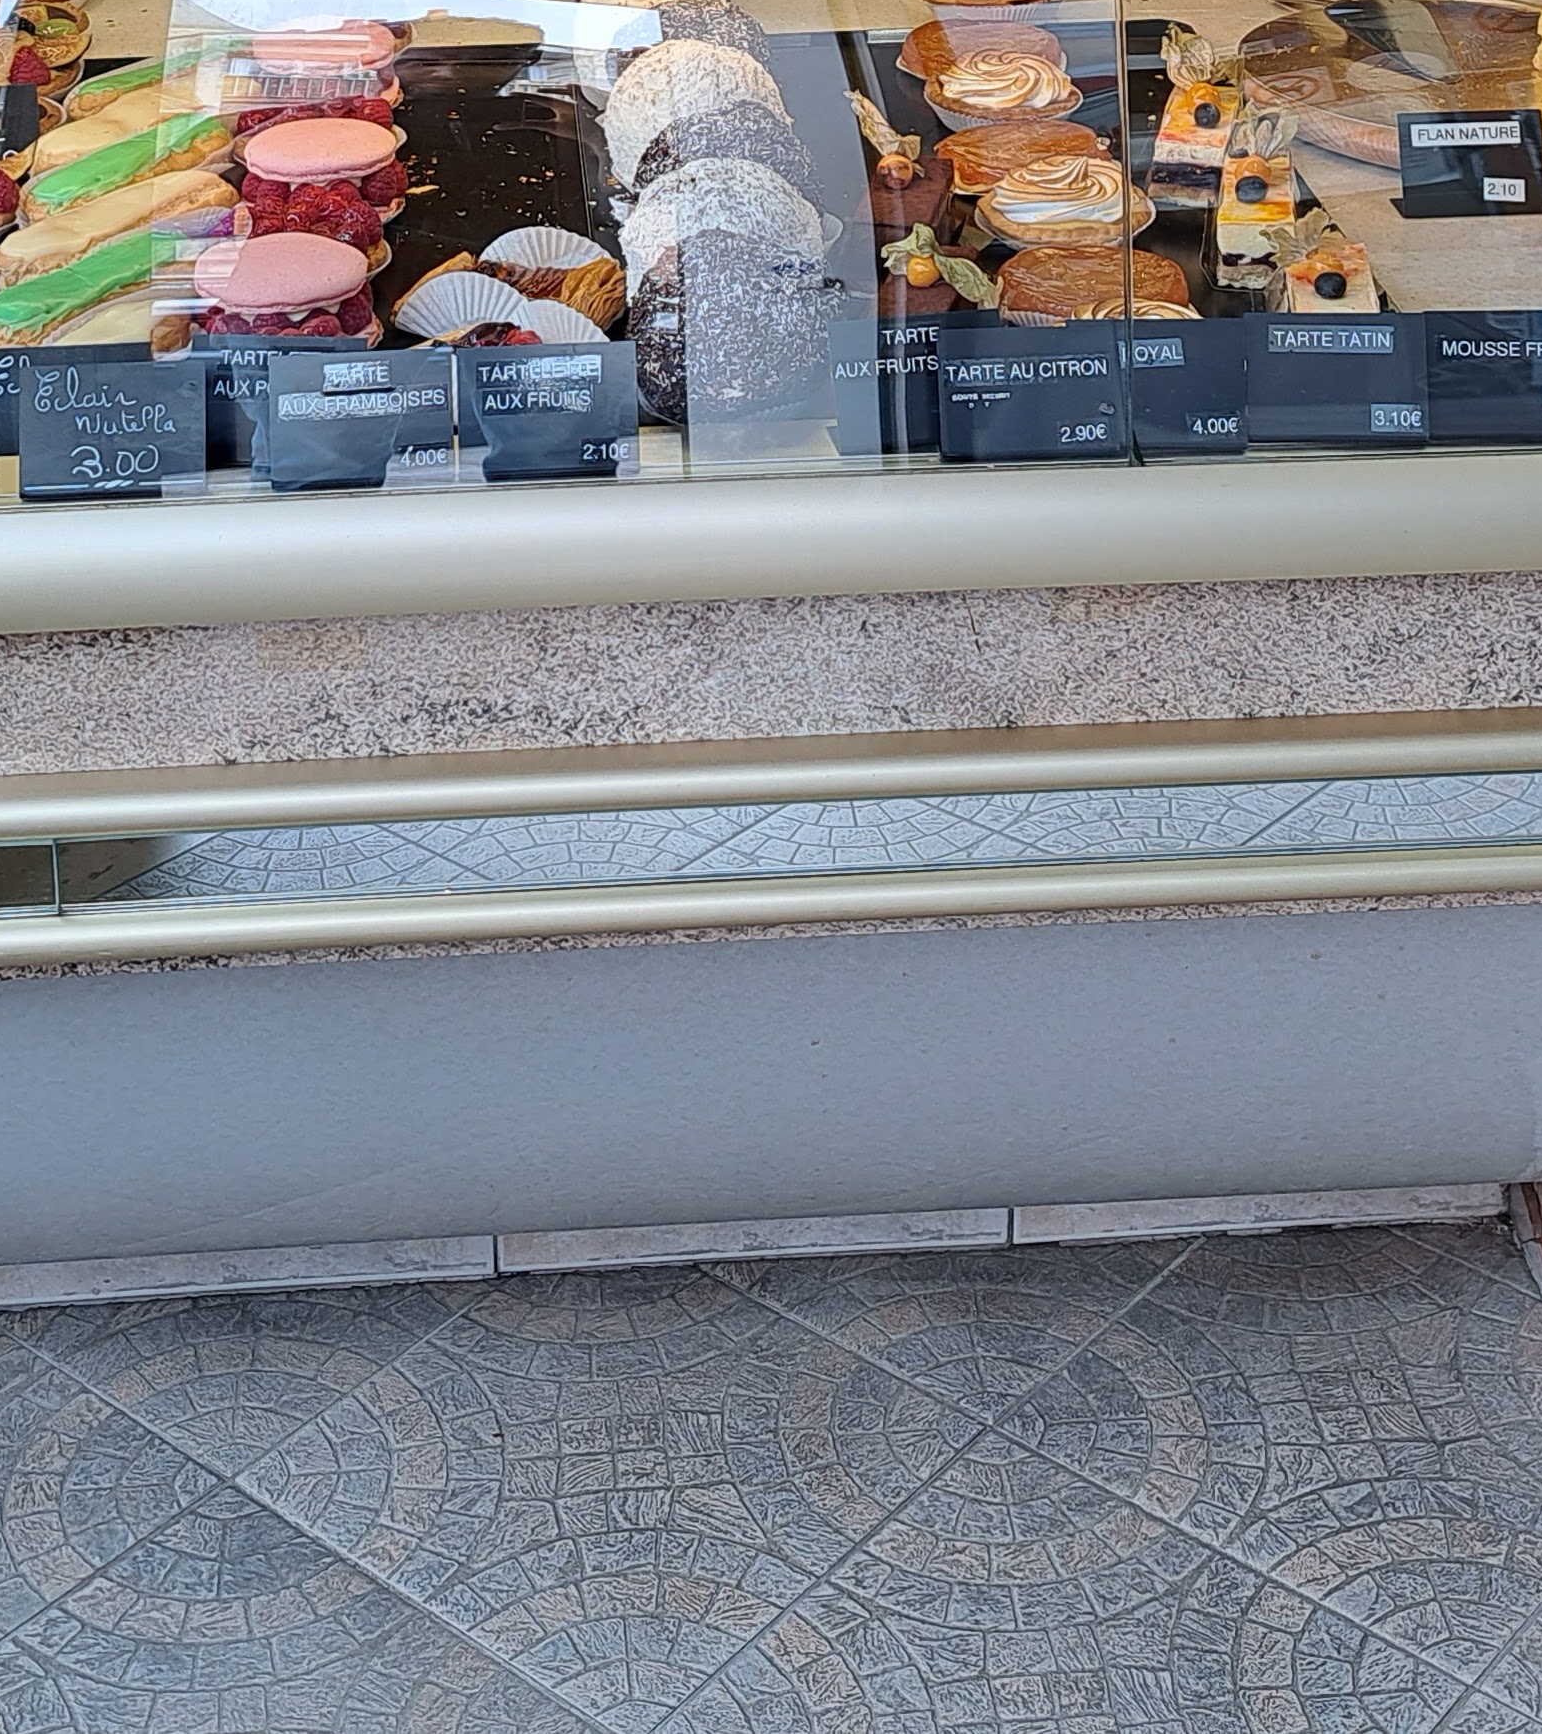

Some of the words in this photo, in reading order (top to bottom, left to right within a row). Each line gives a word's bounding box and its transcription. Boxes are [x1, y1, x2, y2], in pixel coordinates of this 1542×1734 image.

[1417, 127, 1456, 142] FLAN
[1459, 125, 1519, 141] NATURE
[1487, 182, 1517, 197] 2.10
[881, 326, 939, 346] TARTE
[1273, 330, 1333, 348] TARTE
[1337, 330, 1392, 348] TATIN
[1441, 339, 1522, 358] MOUSSE
[323, 365, 390, 386] TARTE
[834, 360, 873, 380] AUX
[875, 355, 939, 377] FRUITS
[945, 364, 1005, 382] TARTE
[1009, 363, 1036, 380] AU
[1039, 358, 1108, 378] CITRON
[214, 379, 250, 398] AUX
[280, 398, 319, 417] AUX
[323, 388, 447, 412] FRAMBOISES
[484, 393, 525, 411] AUX
[527, 390, 592, 408] FRUITS
[1374, 410, 1422, 428] 3.10€
[1060, 423, 1108, 443] 2.90€
[582, 442, 631, 460] 2.10€
